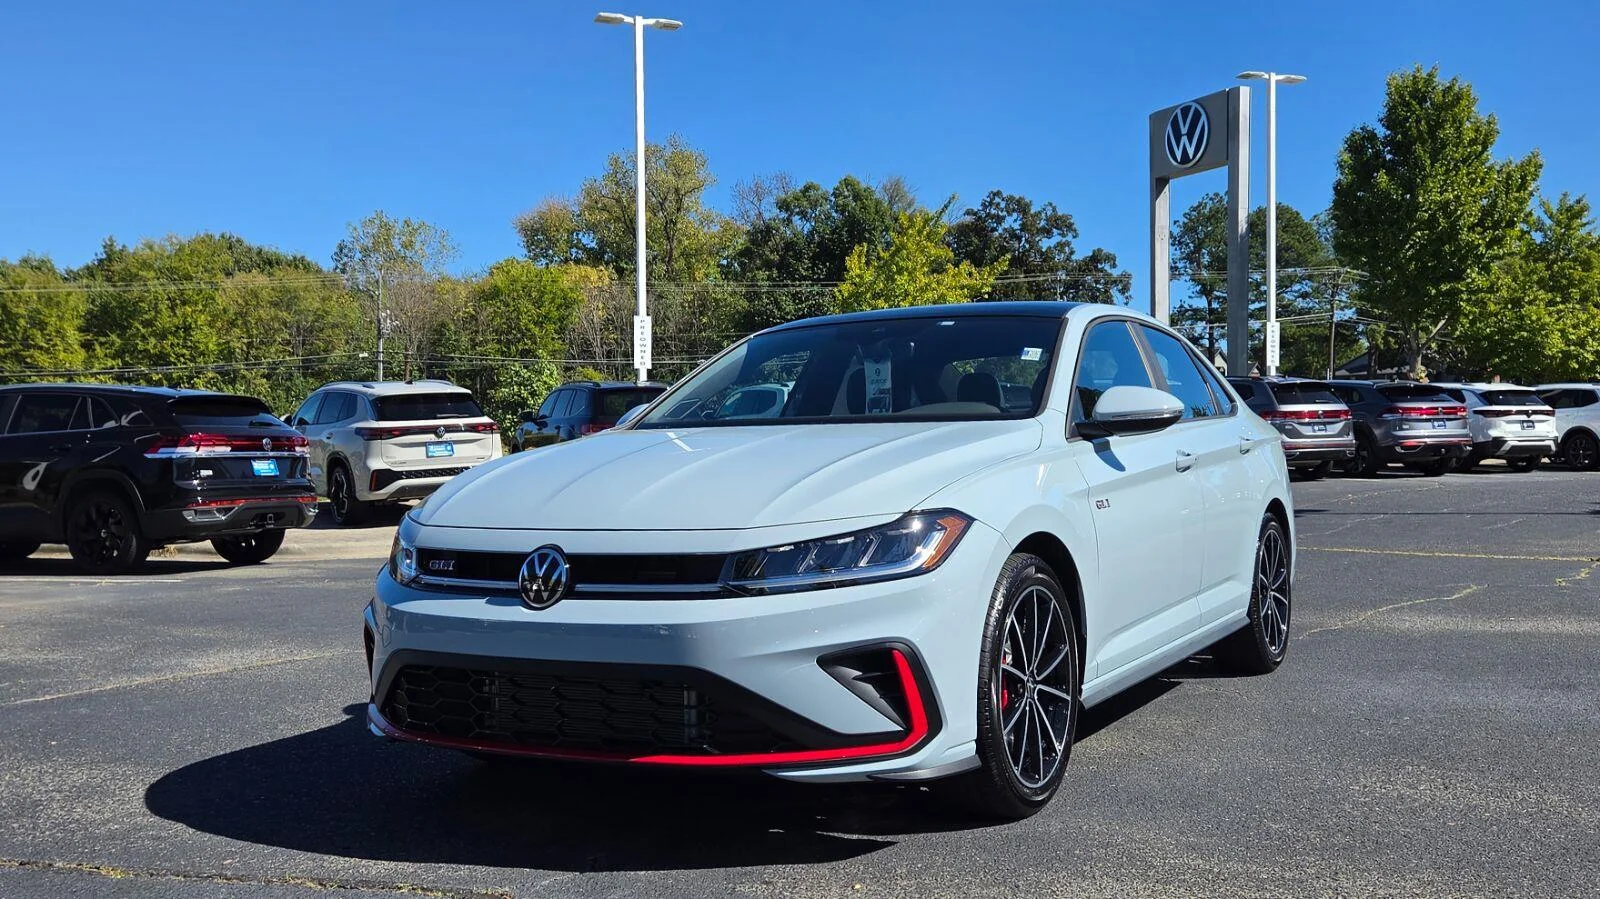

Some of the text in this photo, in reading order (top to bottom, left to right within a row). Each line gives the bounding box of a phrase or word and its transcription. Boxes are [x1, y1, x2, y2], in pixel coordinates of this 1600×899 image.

[1165, 102, 1208, 168] VW
[429, 559, 455, 570] GLI
[518, 548, 567, 608] VW
